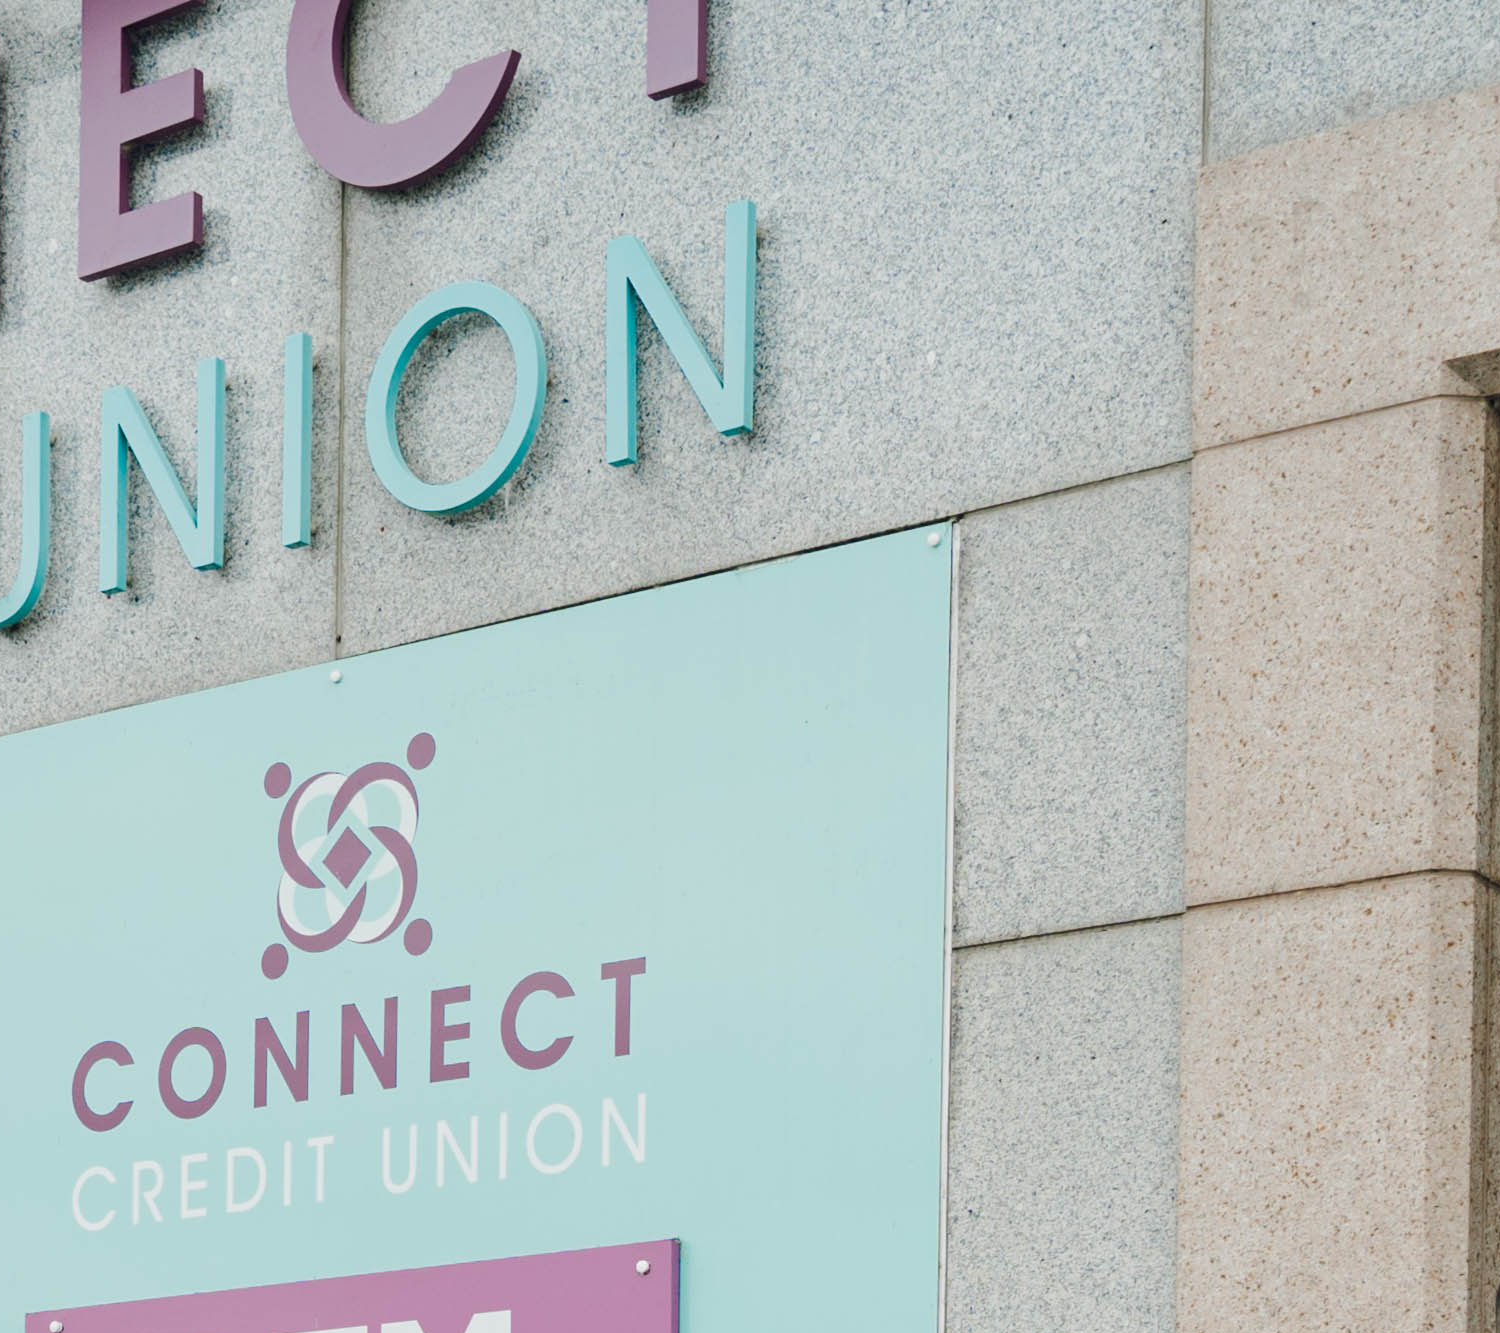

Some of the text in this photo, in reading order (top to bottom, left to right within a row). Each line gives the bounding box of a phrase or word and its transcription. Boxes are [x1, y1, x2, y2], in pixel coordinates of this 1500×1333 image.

[71, 956, 647, 1133] CONNECT
[71, 1092, 648, 1232] CREDIT UNION
